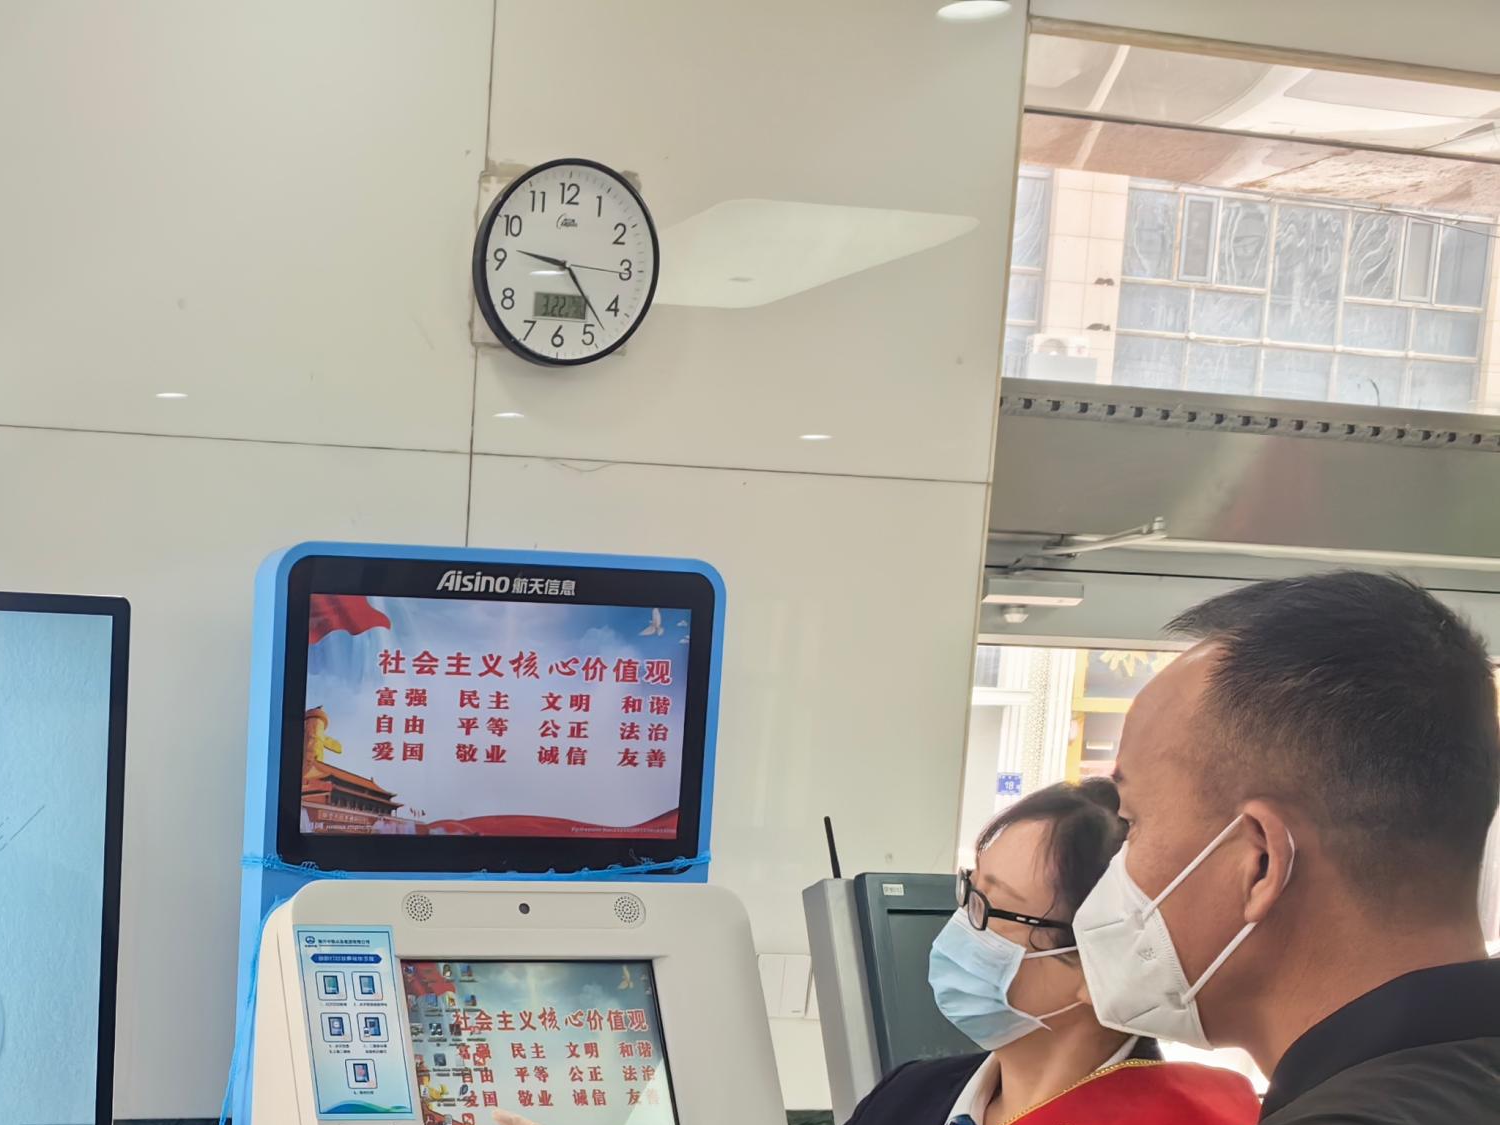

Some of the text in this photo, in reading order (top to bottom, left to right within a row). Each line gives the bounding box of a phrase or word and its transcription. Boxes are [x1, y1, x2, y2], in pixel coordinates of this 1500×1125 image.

[530, 190, 546, 213] 11
[560, 182, 580, 206] 12
[596, 195, 603, 218] 1
[504, 214, 522, 237] 10
[612, 222, 627, 245] 2
[494, 248, 507, 271] 9
[619, 259, 632, 281] 3
[501, 287, 515, 310] 8
[605, 295, 619, 317] 4
[523, 320, 537, 341] 7
[551, 325, 564, 347] 6
[581, 324, 595, 346] 5
[436, 570, 576, 596] Aisino 航天信息
[378, 649, 673, 686] 社会主义核心价值观
[375, 687, 671, 716] 富强 民主 文明 和谐
[375, 714, 668, 742] 自由 平等 公正 法治
[372, 741, 667, 769] 爱国 敬业 诚信 友善
[452, 1006, 649, 1034] 社会主义核心价值观
[510, 1042, 547, 1060] 民主
[566, 1041, 600, 1060] 文明
[619, 1041, 653, 1059] 和谐
[461, 1064, 657, 1084] 自由 平等 公正 法治
[517, 1089, 554, 1108] 敬业
[572, 1089, 608, 1107] 诚信
